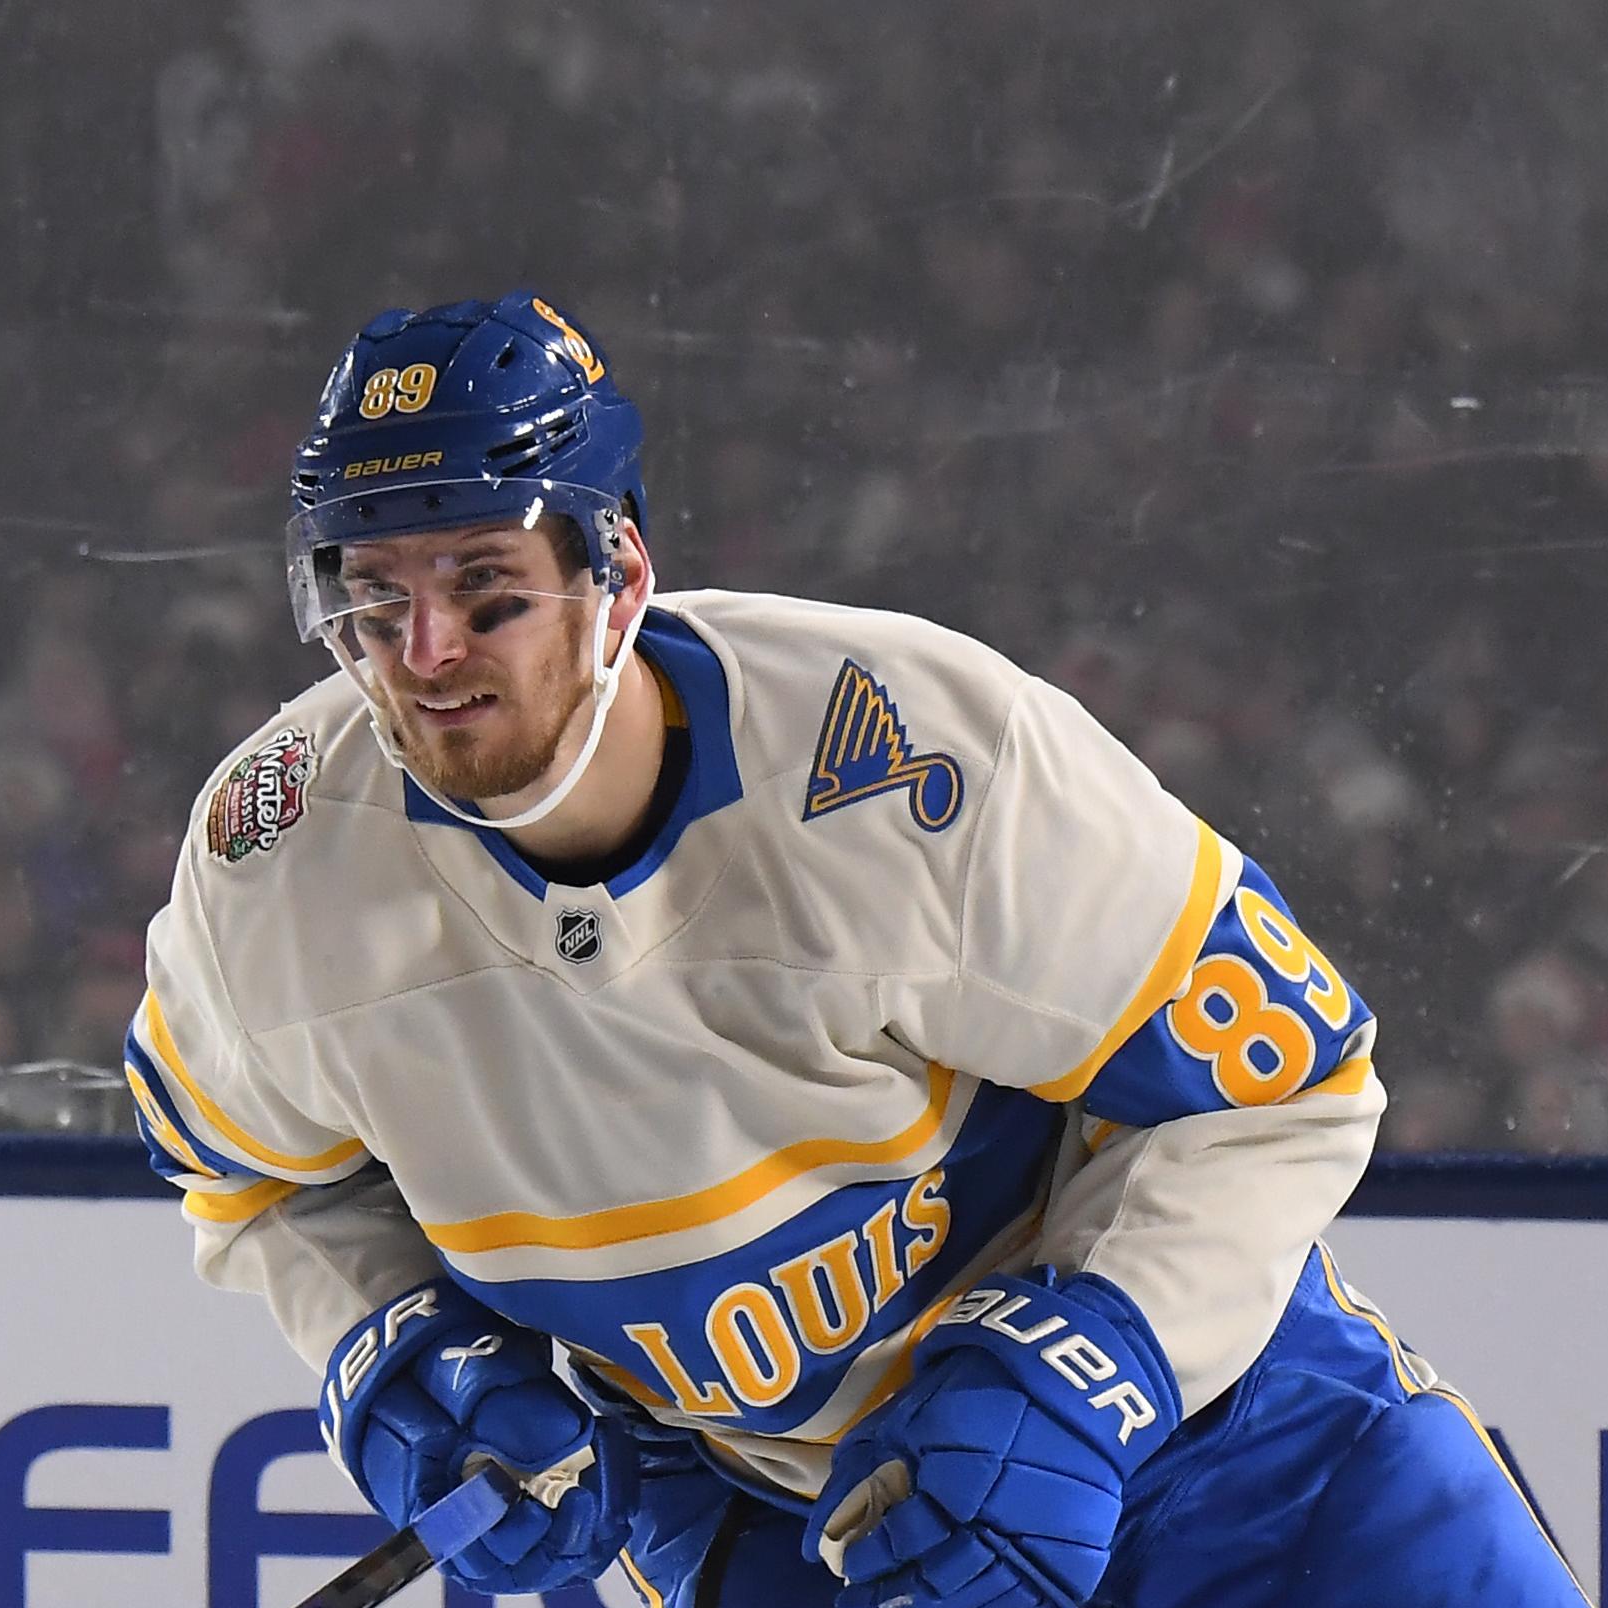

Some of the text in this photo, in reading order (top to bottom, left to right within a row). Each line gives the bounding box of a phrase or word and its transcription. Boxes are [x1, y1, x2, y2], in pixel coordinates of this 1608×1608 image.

[359, 362, 437, 420] 89
[343, 451, 443, 480] BAUER
[241, 769, 255, 834] CLASSIC
[256, 729, 295, 849] Winter
[564, 922, 593, 953] NHL
[1166, 886, 1351, 1109] 89
[621, 1167, 953, 1417] LOUIS
